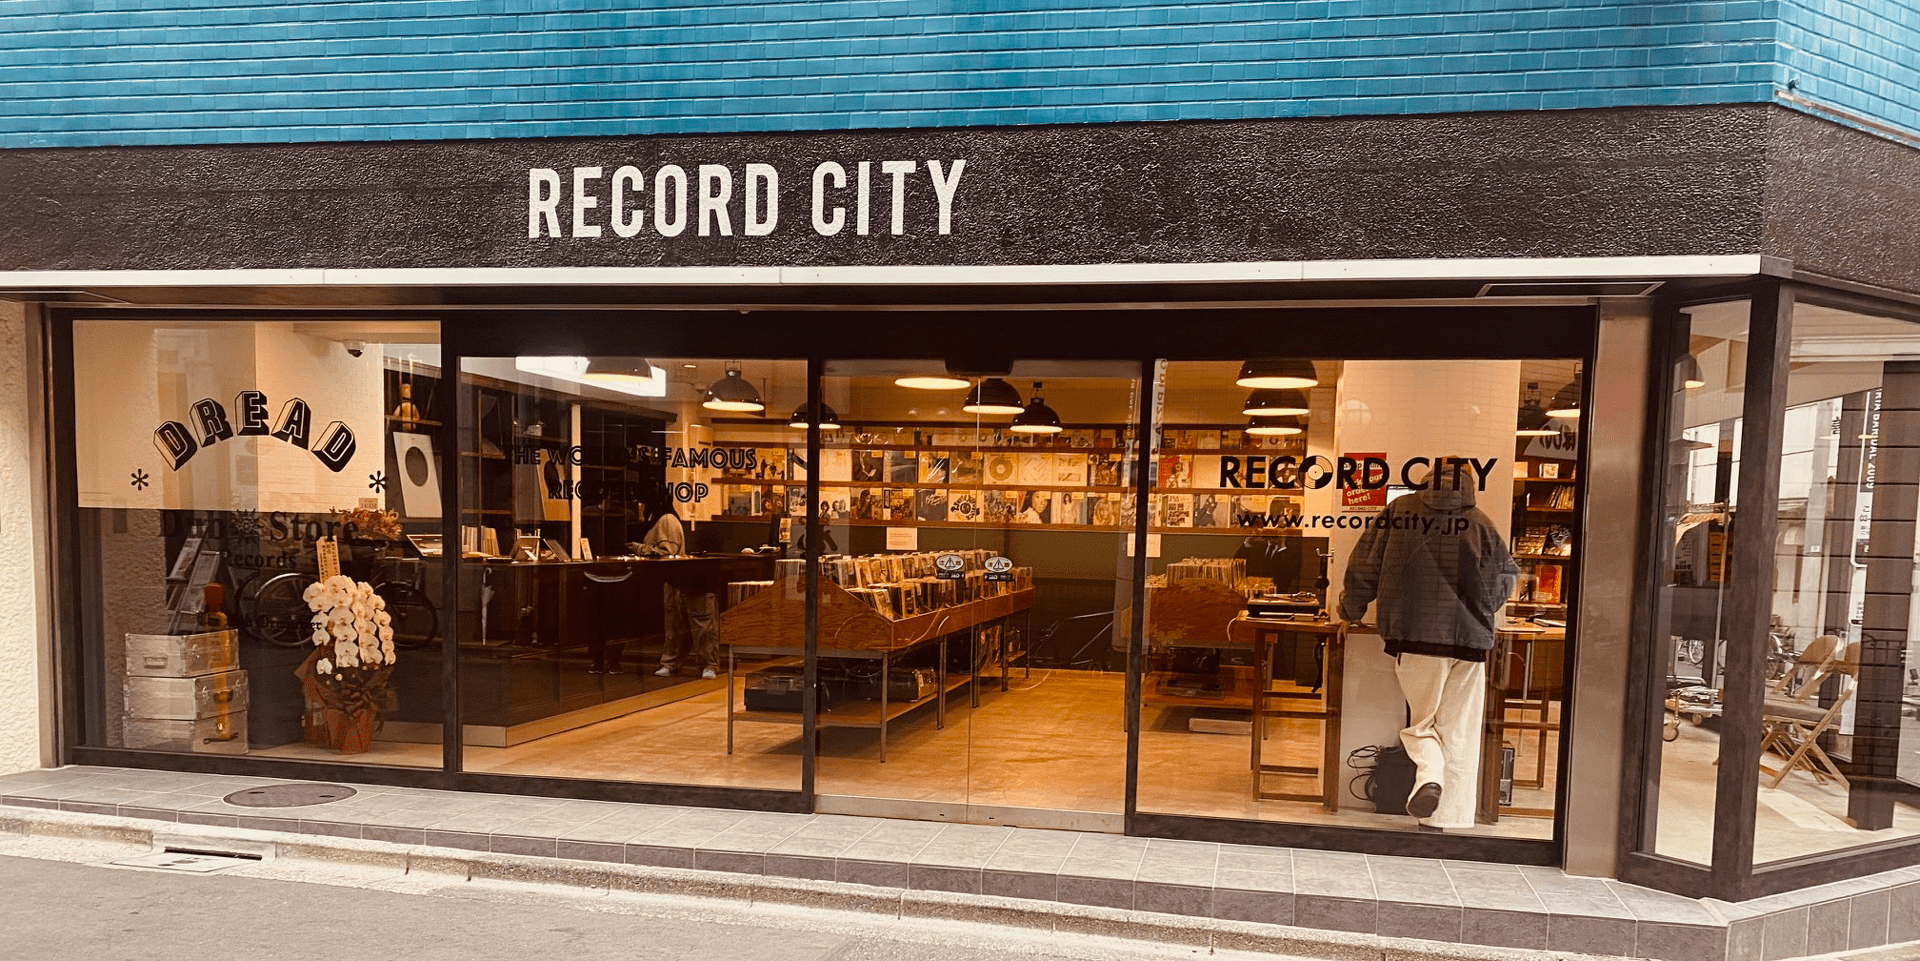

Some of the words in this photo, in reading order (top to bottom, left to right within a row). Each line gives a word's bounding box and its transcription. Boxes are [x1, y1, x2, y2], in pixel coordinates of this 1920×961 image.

[528, 163, 779, 238] RECORD
[811, 159, 967, 236] CITY
[153, 390, 356, 473] DREAD
[663, 446, 757, 470] FAMOUS
[1220, 455, 1391, 489] RECORD
[1401, 456, 1498, 491] CITY
[653, 481, 709, 503] HOP
[1347, 492, 1371, 505] here!
[270, 510, 360, 542] Store
[1237, 511, 1470, 536] www.recordcity.jp
[221, 551, 298, 568] Records
